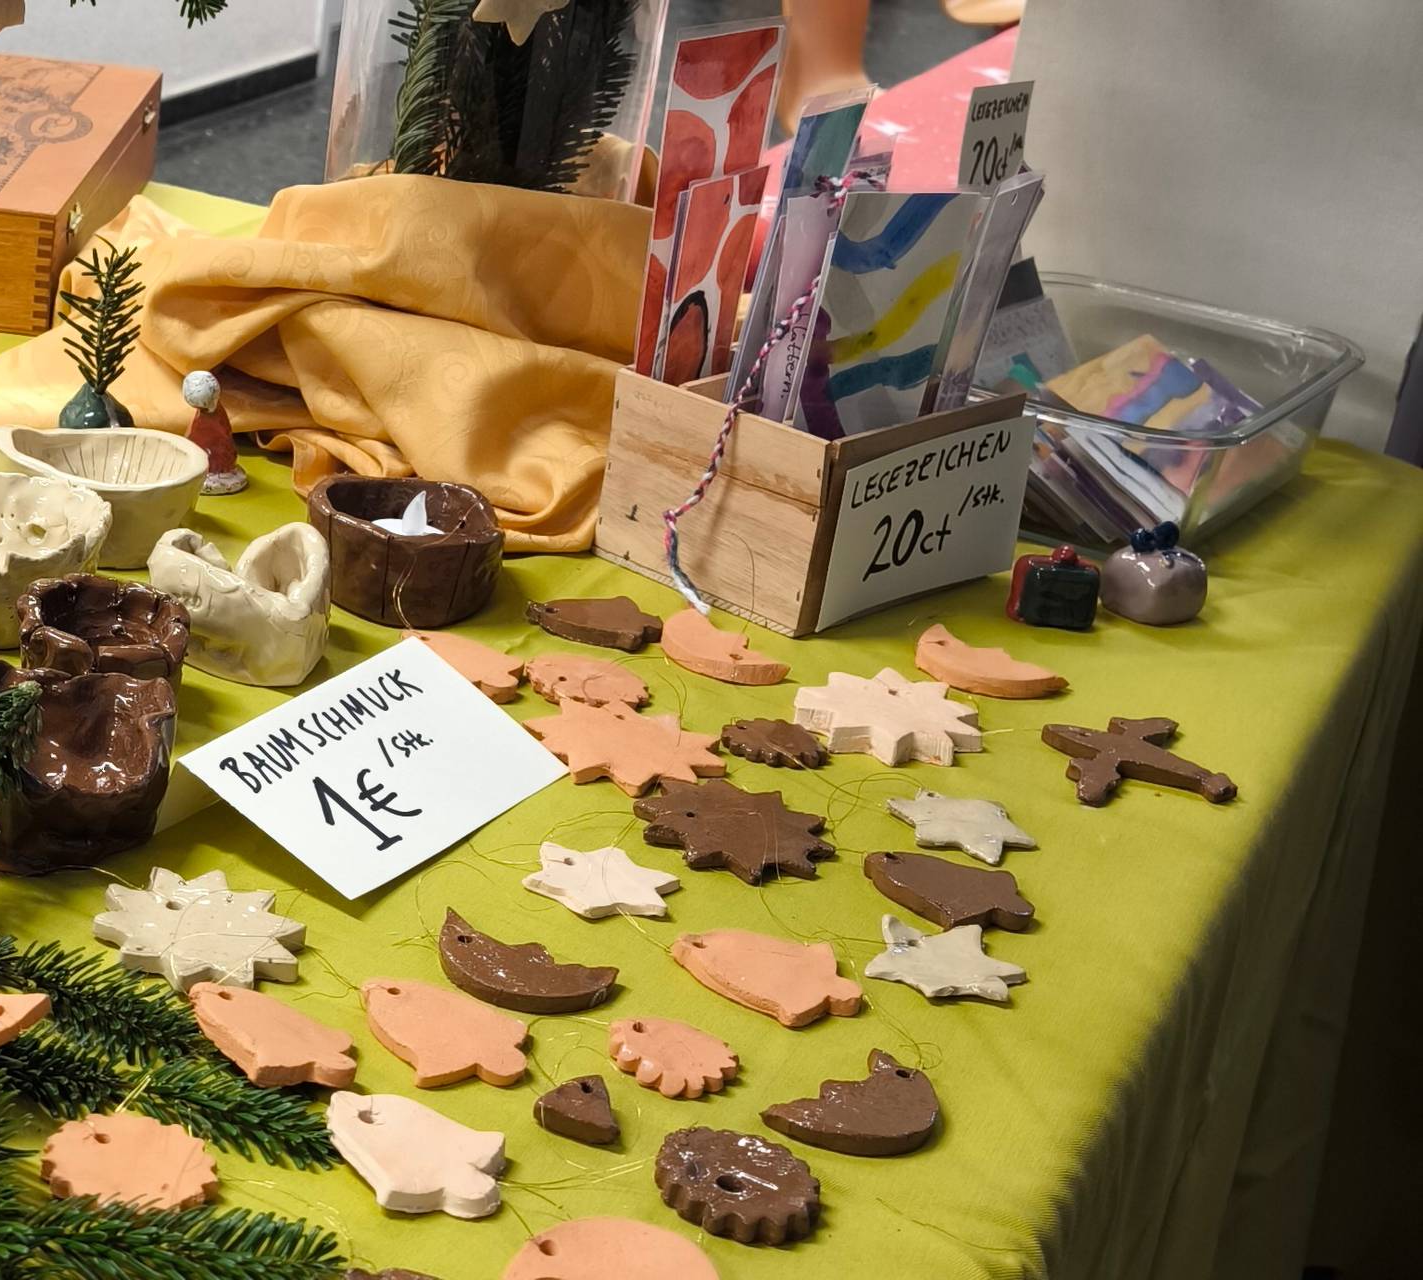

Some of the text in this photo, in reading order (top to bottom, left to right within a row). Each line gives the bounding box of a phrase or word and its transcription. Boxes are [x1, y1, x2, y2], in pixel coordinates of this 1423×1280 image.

[851, 430, 1011, 509] LESEZEICHEN
[862, 509, 952, 582] 20ct
[219, 669, 424, 794] BAUMSCHMUCK
[312, 769, 423, 851] 1€
